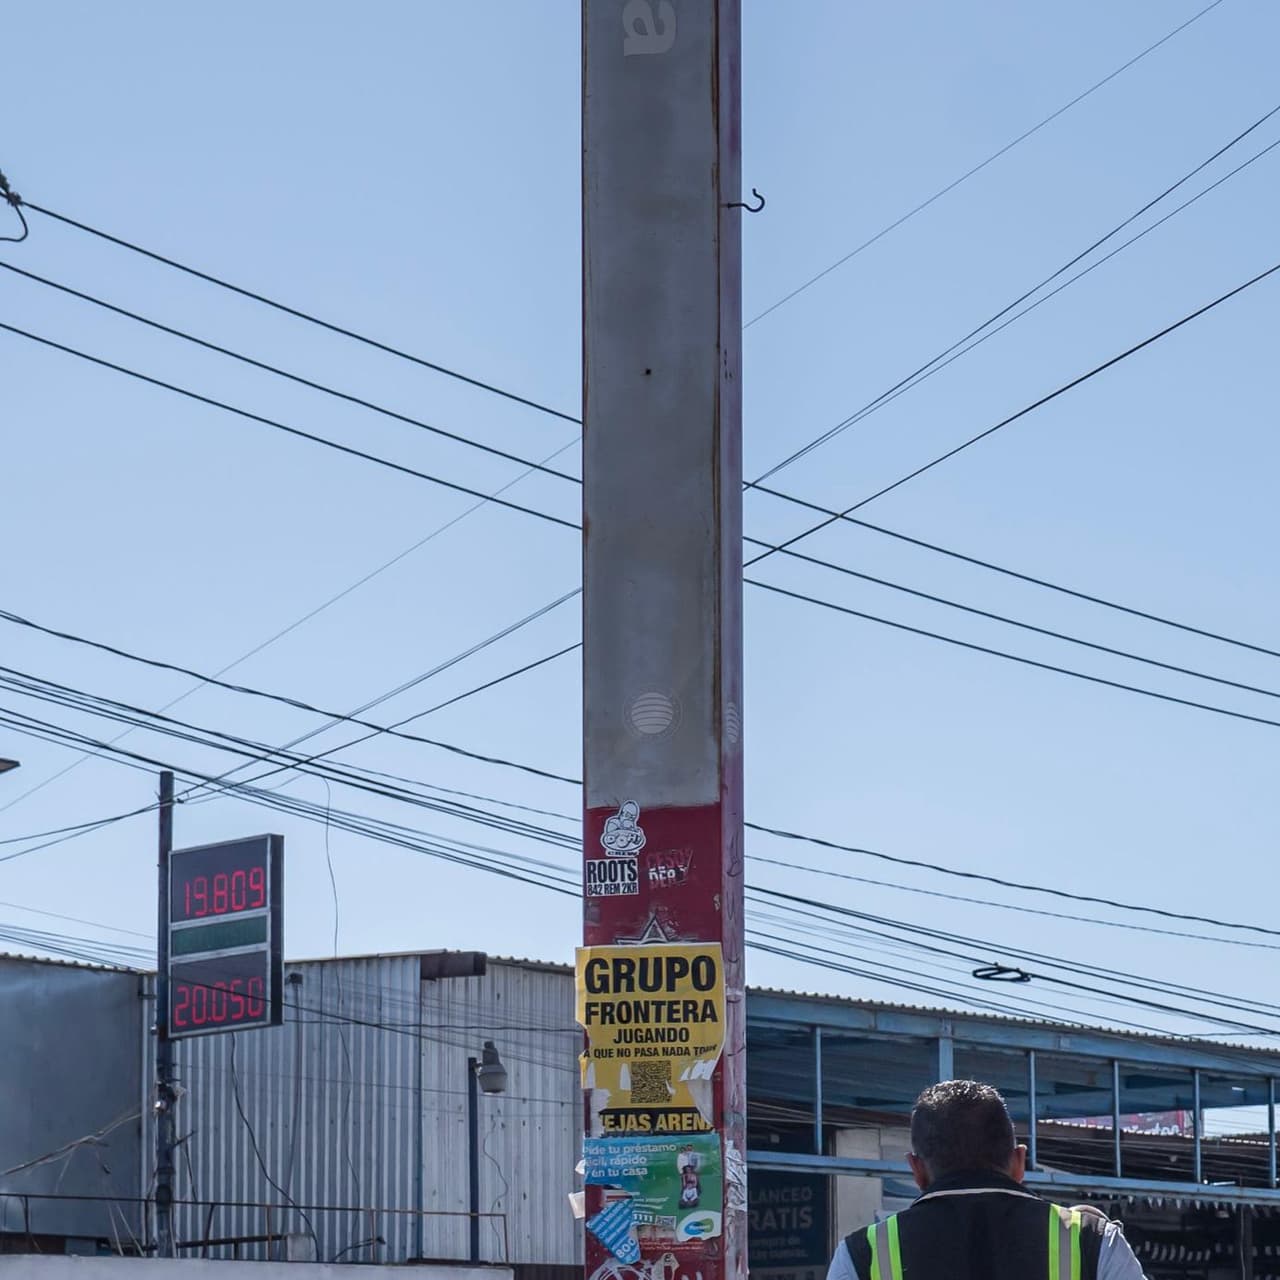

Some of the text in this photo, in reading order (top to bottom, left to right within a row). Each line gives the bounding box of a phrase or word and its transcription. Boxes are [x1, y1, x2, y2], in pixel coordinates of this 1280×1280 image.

[587, 860, 637, 883] ROOTS
[184, 867, 265, 916] 19.809
[604, 883, 620, 895] REM
[584, 955, 717, 994] GRUPO
[585, 1000, 718, 1025] FRONTERA
[613, 1027, 690, 1044] JUGANDO
[583, 1050, 591, 1058] A
[594, 1049, 614, 1058] QUE
[617, 1049, 631, 1058] NO
[634, 1047, 658, 1057] PASA
[662, 1047, 687, 1057] NADA
[602, 1113, 650, 1132] EJAS
[608, 1145, 620, 1154] tu
[623, 1143, 677, 1155] préstamo
[608, 1169, 620, 1177] tu
[622, 1167, 648, 1176] casa
